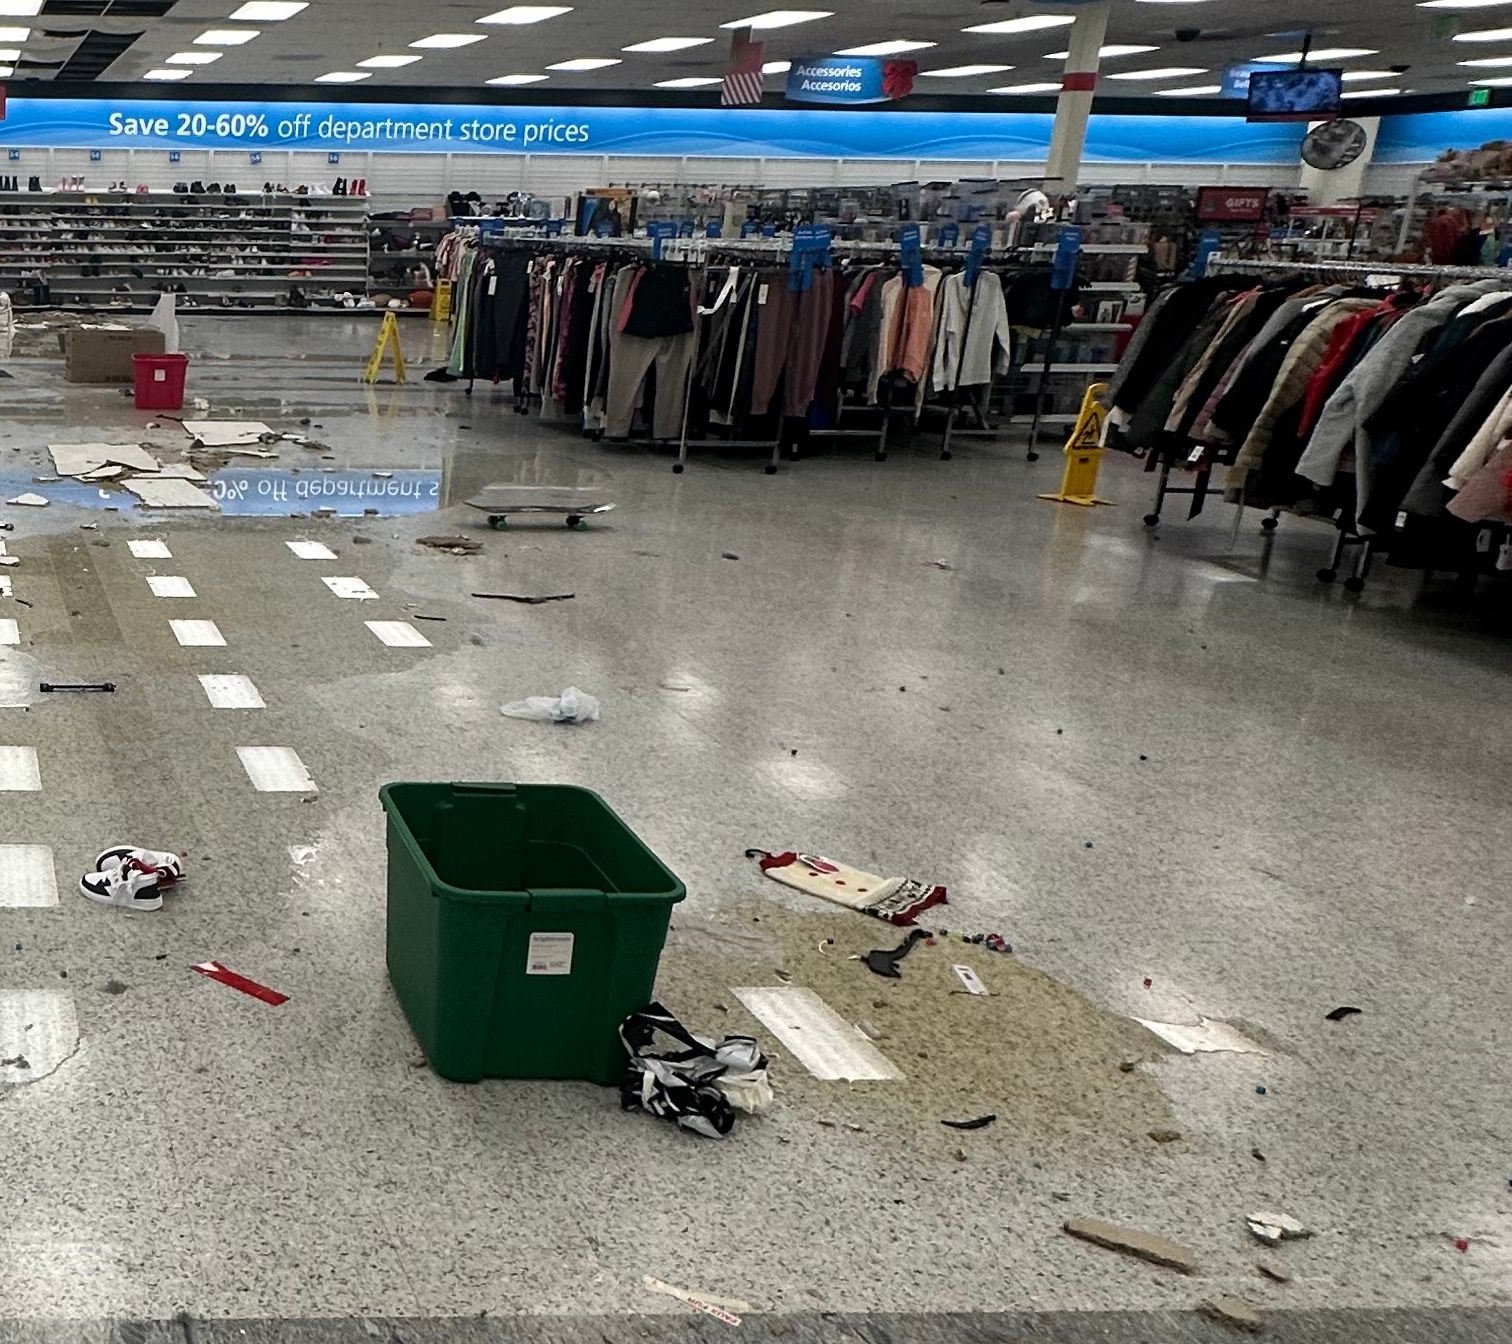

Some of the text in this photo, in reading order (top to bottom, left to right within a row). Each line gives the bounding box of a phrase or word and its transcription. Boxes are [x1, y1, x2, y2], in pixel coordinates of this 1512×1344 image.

[796, 64, 862, 78] Accessories
[801, 79, 862, 92] Accesorios
[109, 112, 589, 146] Save 20-60% off department store prices
[1225, 198, 1260, 208] GIFTS
